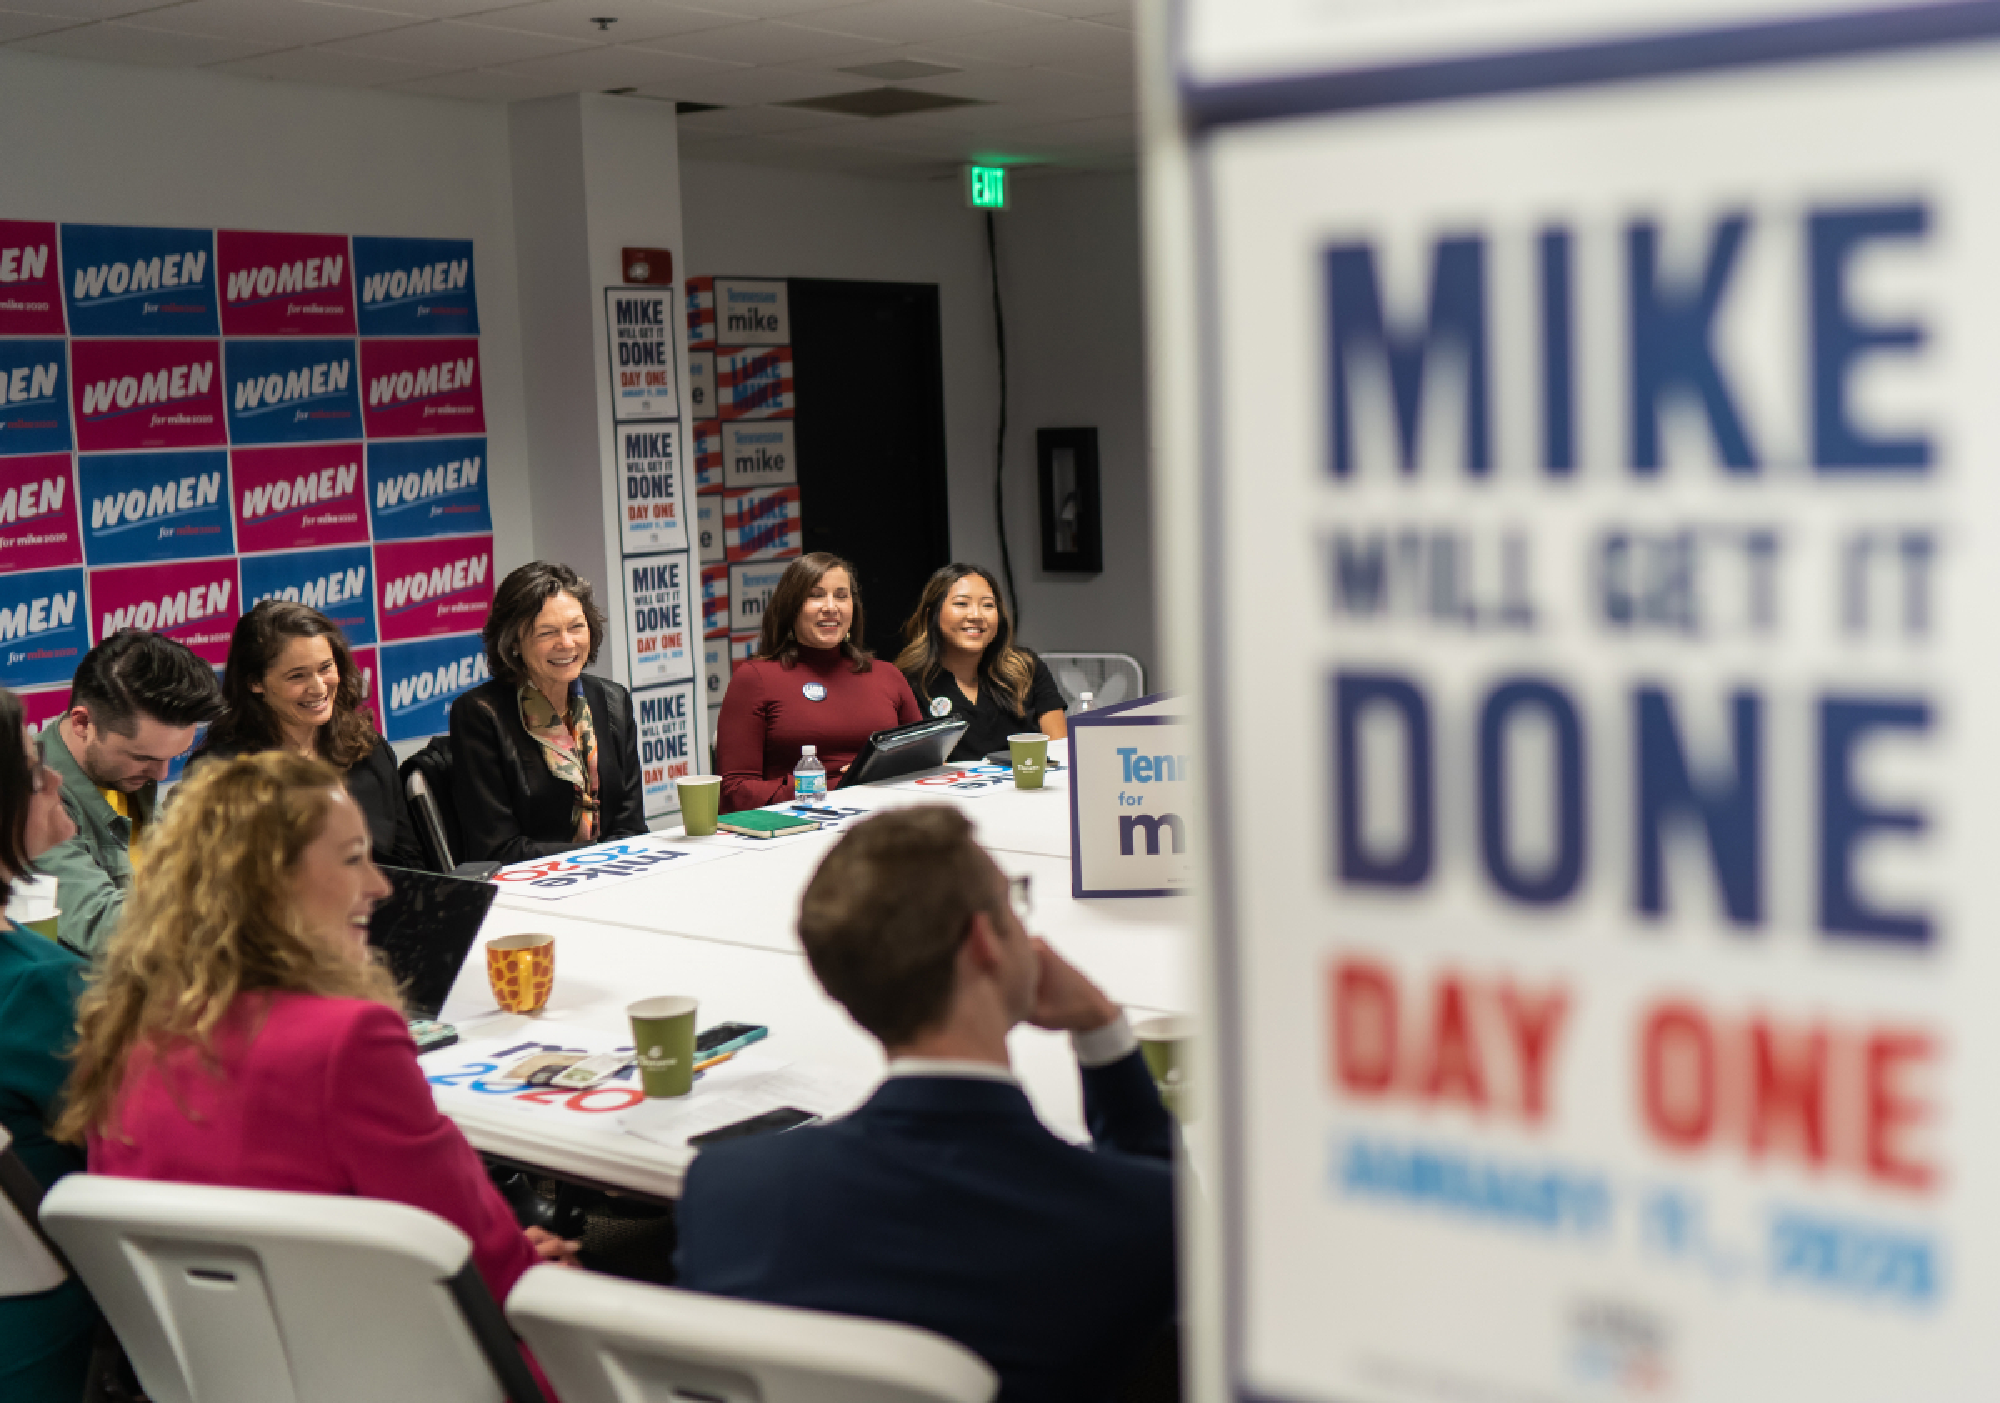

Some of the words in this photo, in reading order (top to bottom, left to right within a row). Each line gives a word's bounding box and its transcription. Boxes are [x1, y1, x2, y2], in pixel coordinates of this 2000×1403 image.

[972, 166, 1004, 207] EXIT
[73, 250, 207, 299] WOMEN
[227, 254, 343, 301] WOMEN
[362, 257, 468, 303] WOMEN
[617, 298, 663, 325] MIKE
[728, 307, 778, 332] mike
[619, 342, 665, 366] DONE
[1322, 202, 1938, 479] MIKE
[0, 362, 58, 405] EN
[83, 360, 213, 414] WOMEN
[234, 358, 349, 410] WOMEN
[369, 356, 474, 405] WOMEN
[620, 370, 641, 387] DAY
[645, 370, 667, 386] ONE
[148, 412, 167, 428] for
[626, 432, 672, 458] MIKE
[735, 447, 785, 473] mike
[92, 471, 220, 528] WOMEN
[243, 463, 357, 518] WOMEN
[377, 455, 480, 508] WOMEN
[627, 474, 674, 499] DONE
[628, 505, 648, 521] DAY
[653, 502, 675, 518] ONE
[158, 526, 174, 540] for
[385, 552, 488, 610] WOMEN
[633, 563, 680, 592] MIKE
[1322, 522, 1537, 633] WILL
[1598, 524, 1781, 642] GET
[1842, 526, 1938, 642] IT
[102, 578, 231, 639] WOMEN
[636, 605, 682, 632] DONE
[7, 652, 26, 666] for
[637, 637, 657, 653] DAY
[661, 632, 682, 648] ONE
[391, 652, 489, 710] WOMEN
[641, 693, 685, 725] MIKE
[643, 735, 687, 764] DONE
[644, 768, 663, 785] DAY
[668, 761, 688, 778] ONE
[1118, 791, 1144, 807] for
[1328, 670, 1942, 949] DONE
[1330, 954, 1570, 1127] DAY
[1638, 1002, 1944, 1199] ONE
